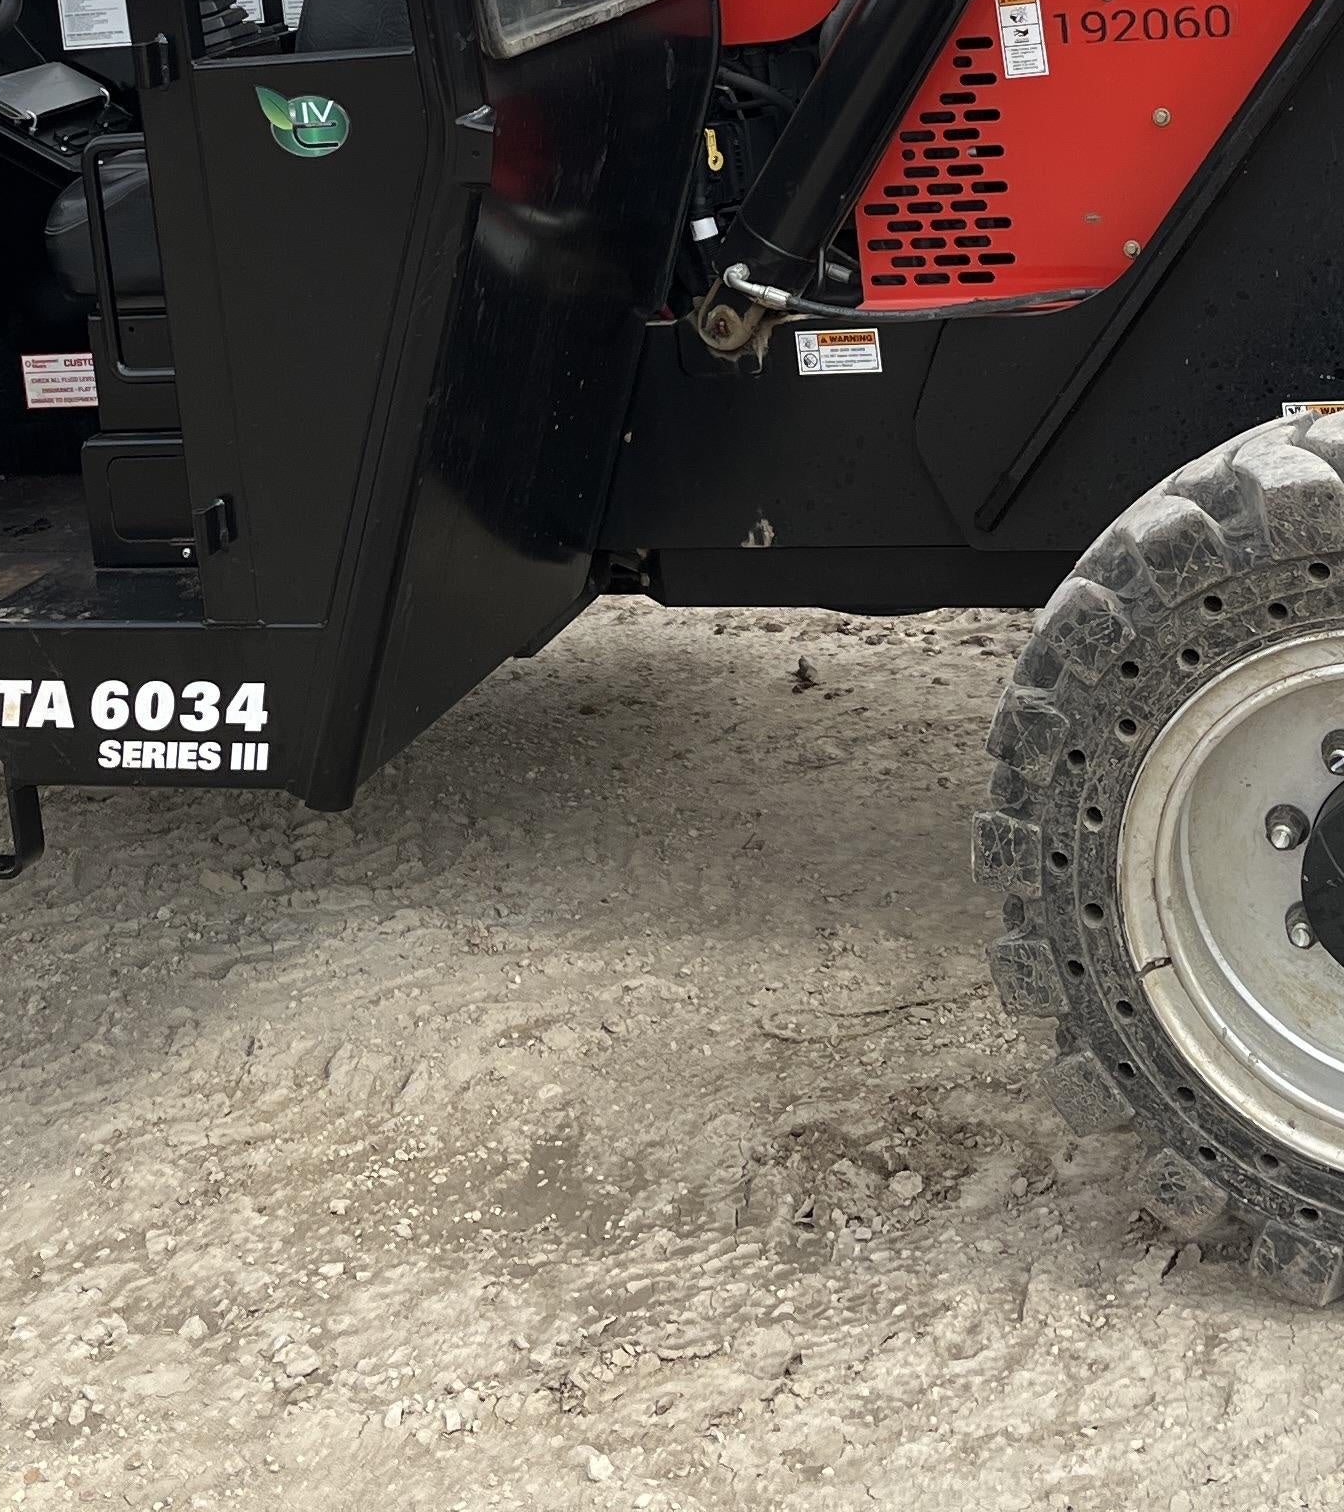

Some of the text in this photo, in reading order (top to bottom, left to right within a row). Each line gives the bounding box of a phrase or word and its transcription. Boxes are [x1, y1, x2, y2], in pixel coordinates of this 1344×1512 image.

[1053, 5, 1231, 44] 192060
[301, 100, 334, 124] IV
[829, 334, 873, 343] WARNING
[90, 680, 269, 732] 6034
[97, 739, 269, 771] SERIES III
